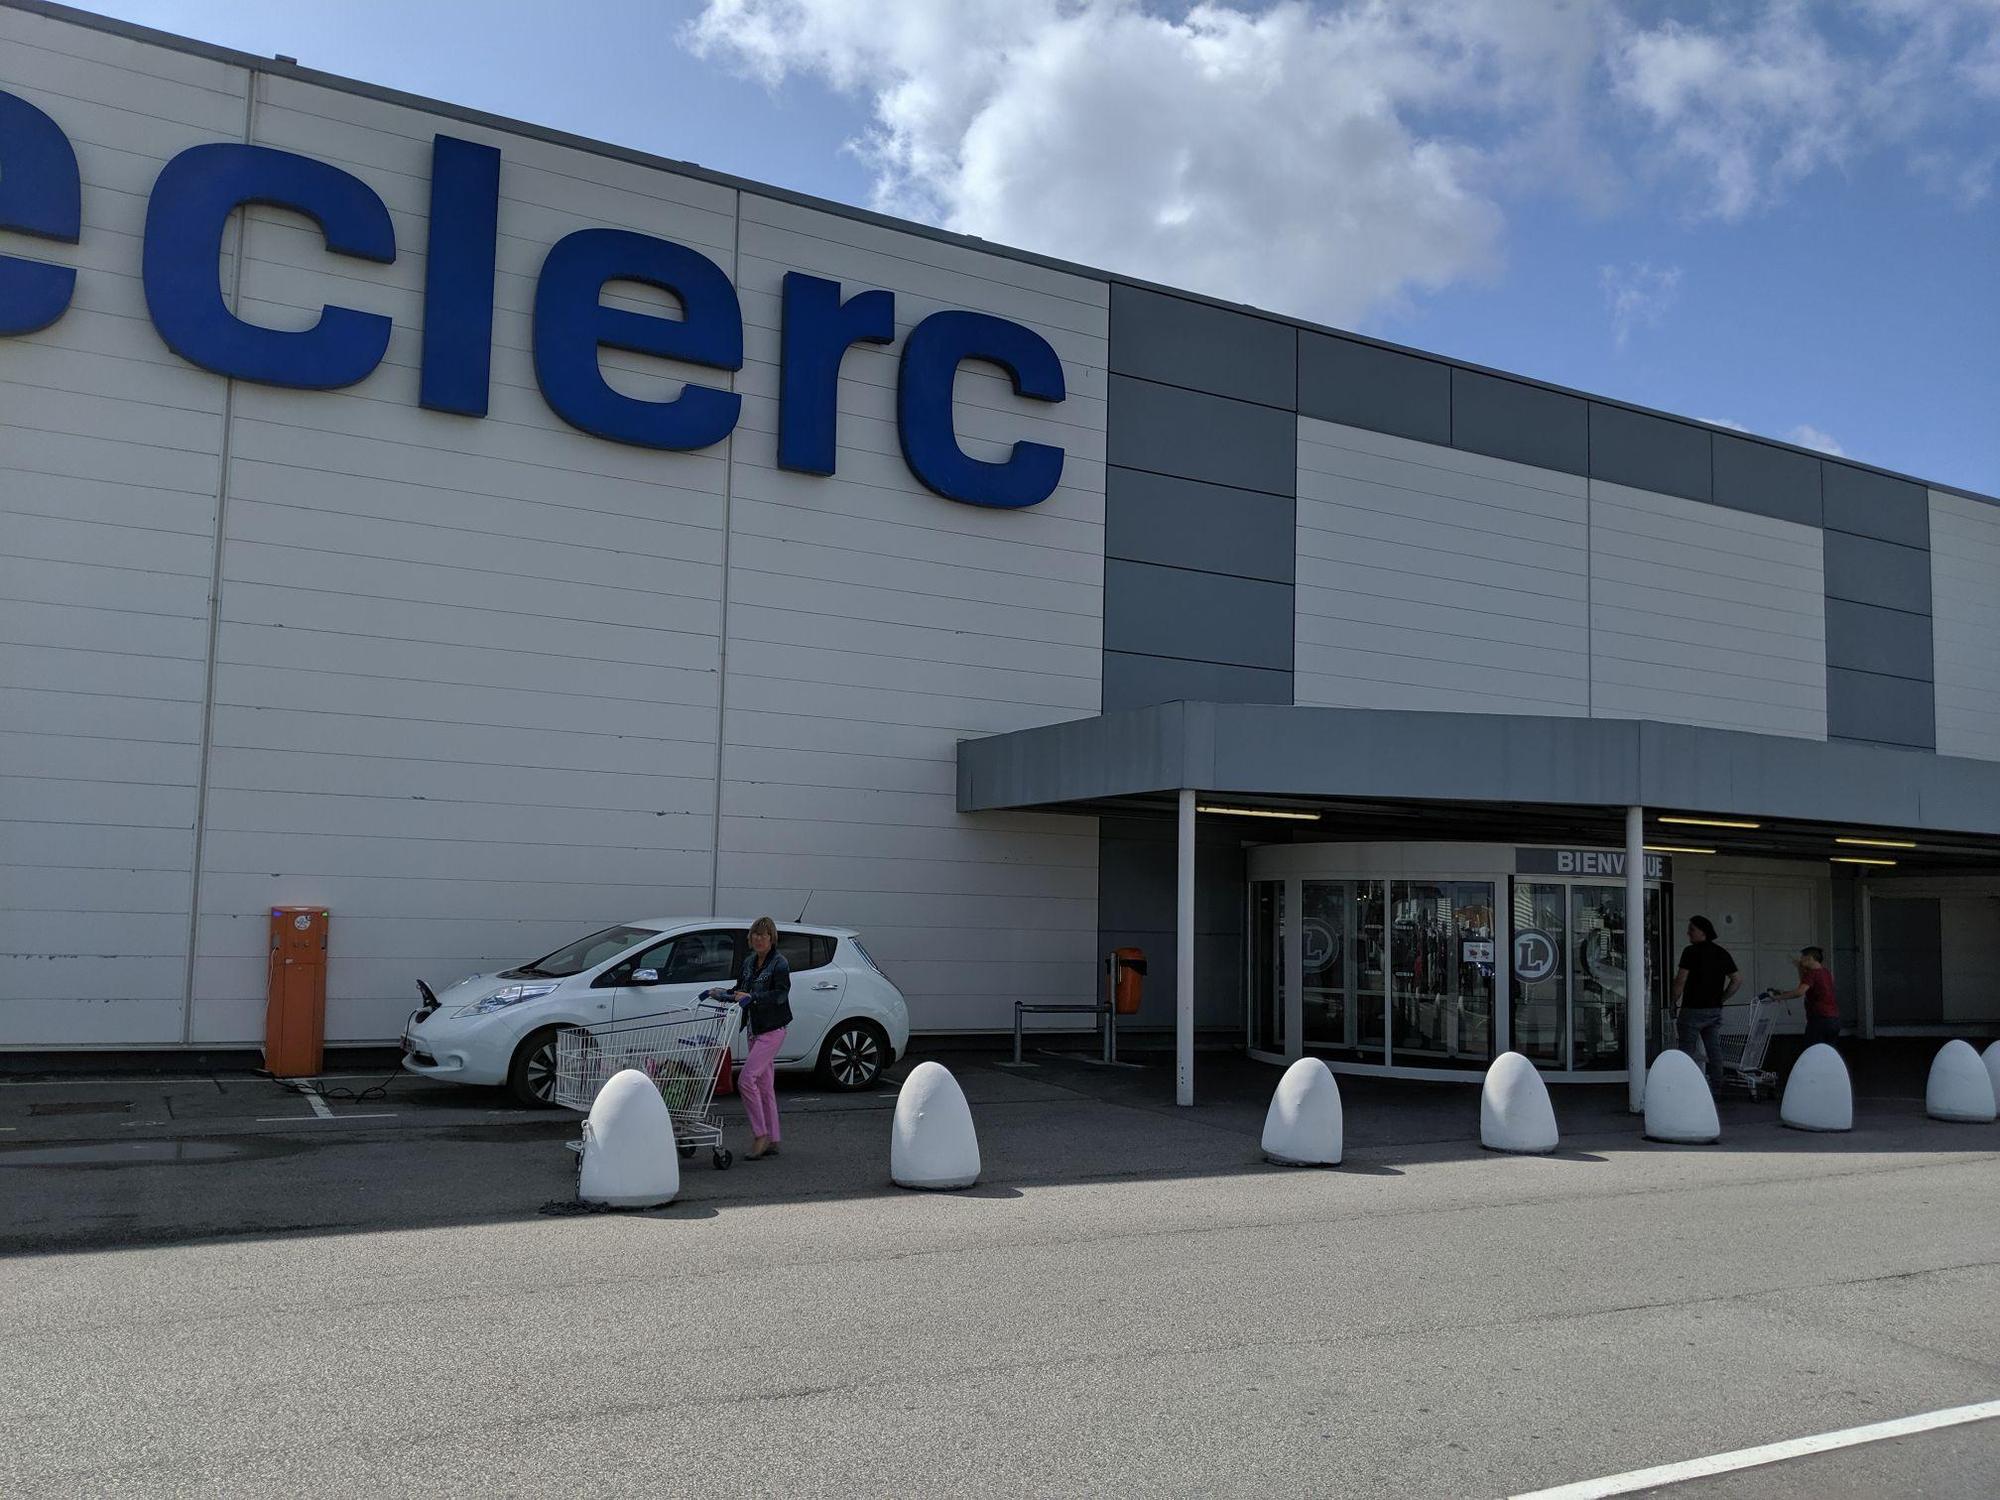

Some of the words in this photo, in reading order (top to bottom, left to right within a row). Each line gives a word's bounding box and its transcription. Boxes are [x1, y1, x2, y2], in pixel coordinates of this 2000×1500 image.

[1557, 851, 1663, 876] BIENVUE
[1302, 931, 1323, 960] L
[1519, 941, 1543, 971] L
